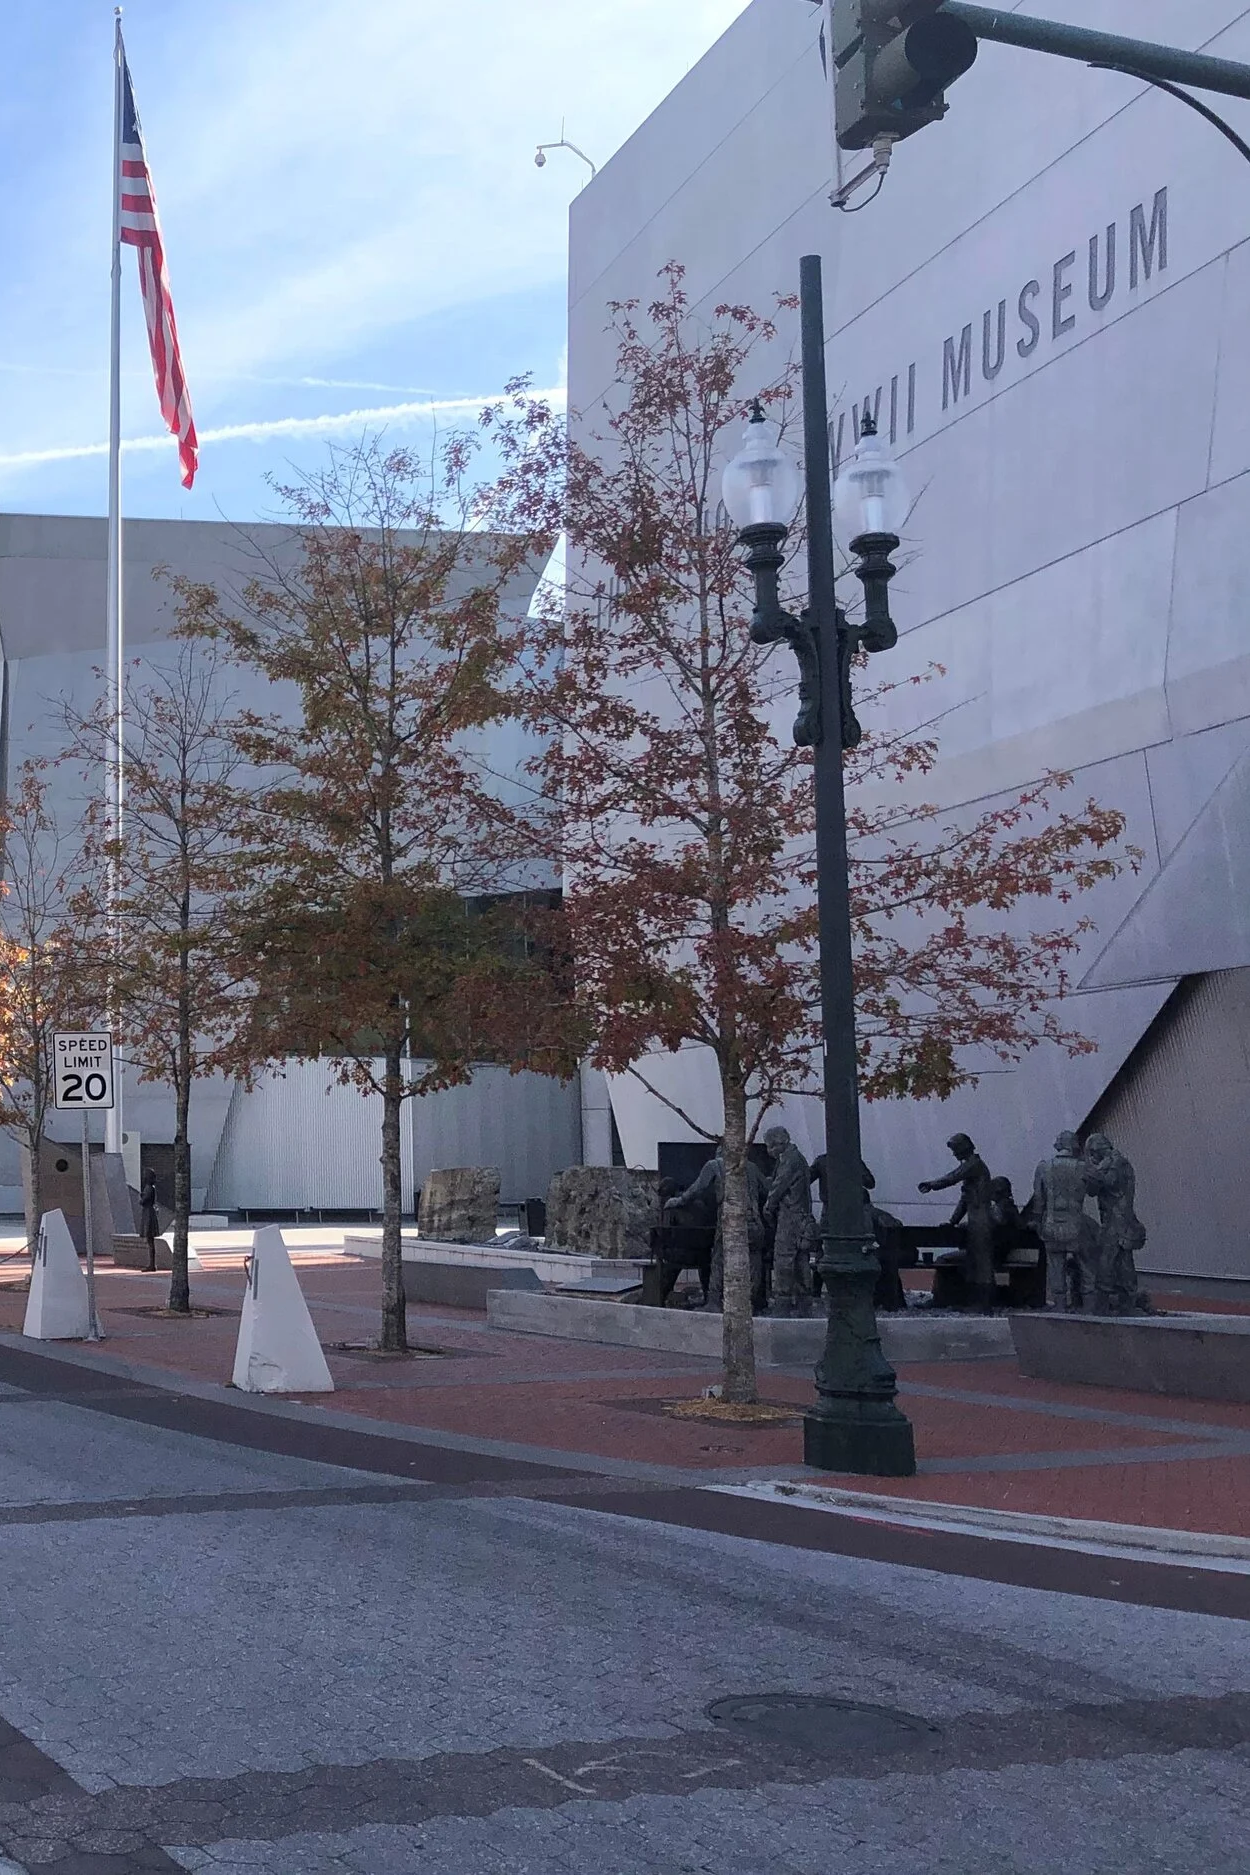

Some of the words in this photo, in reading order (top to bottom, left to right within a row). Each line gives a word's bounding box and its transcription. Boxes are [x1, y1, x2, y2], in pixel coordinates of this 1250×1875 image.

[941, 185, 1168, 412] MUSEUM
[58, 1039, 108, 1052] SPEED
[64, 1056, 102, 1068] LIMIT
[62, 1073, 107, 1101] 20
